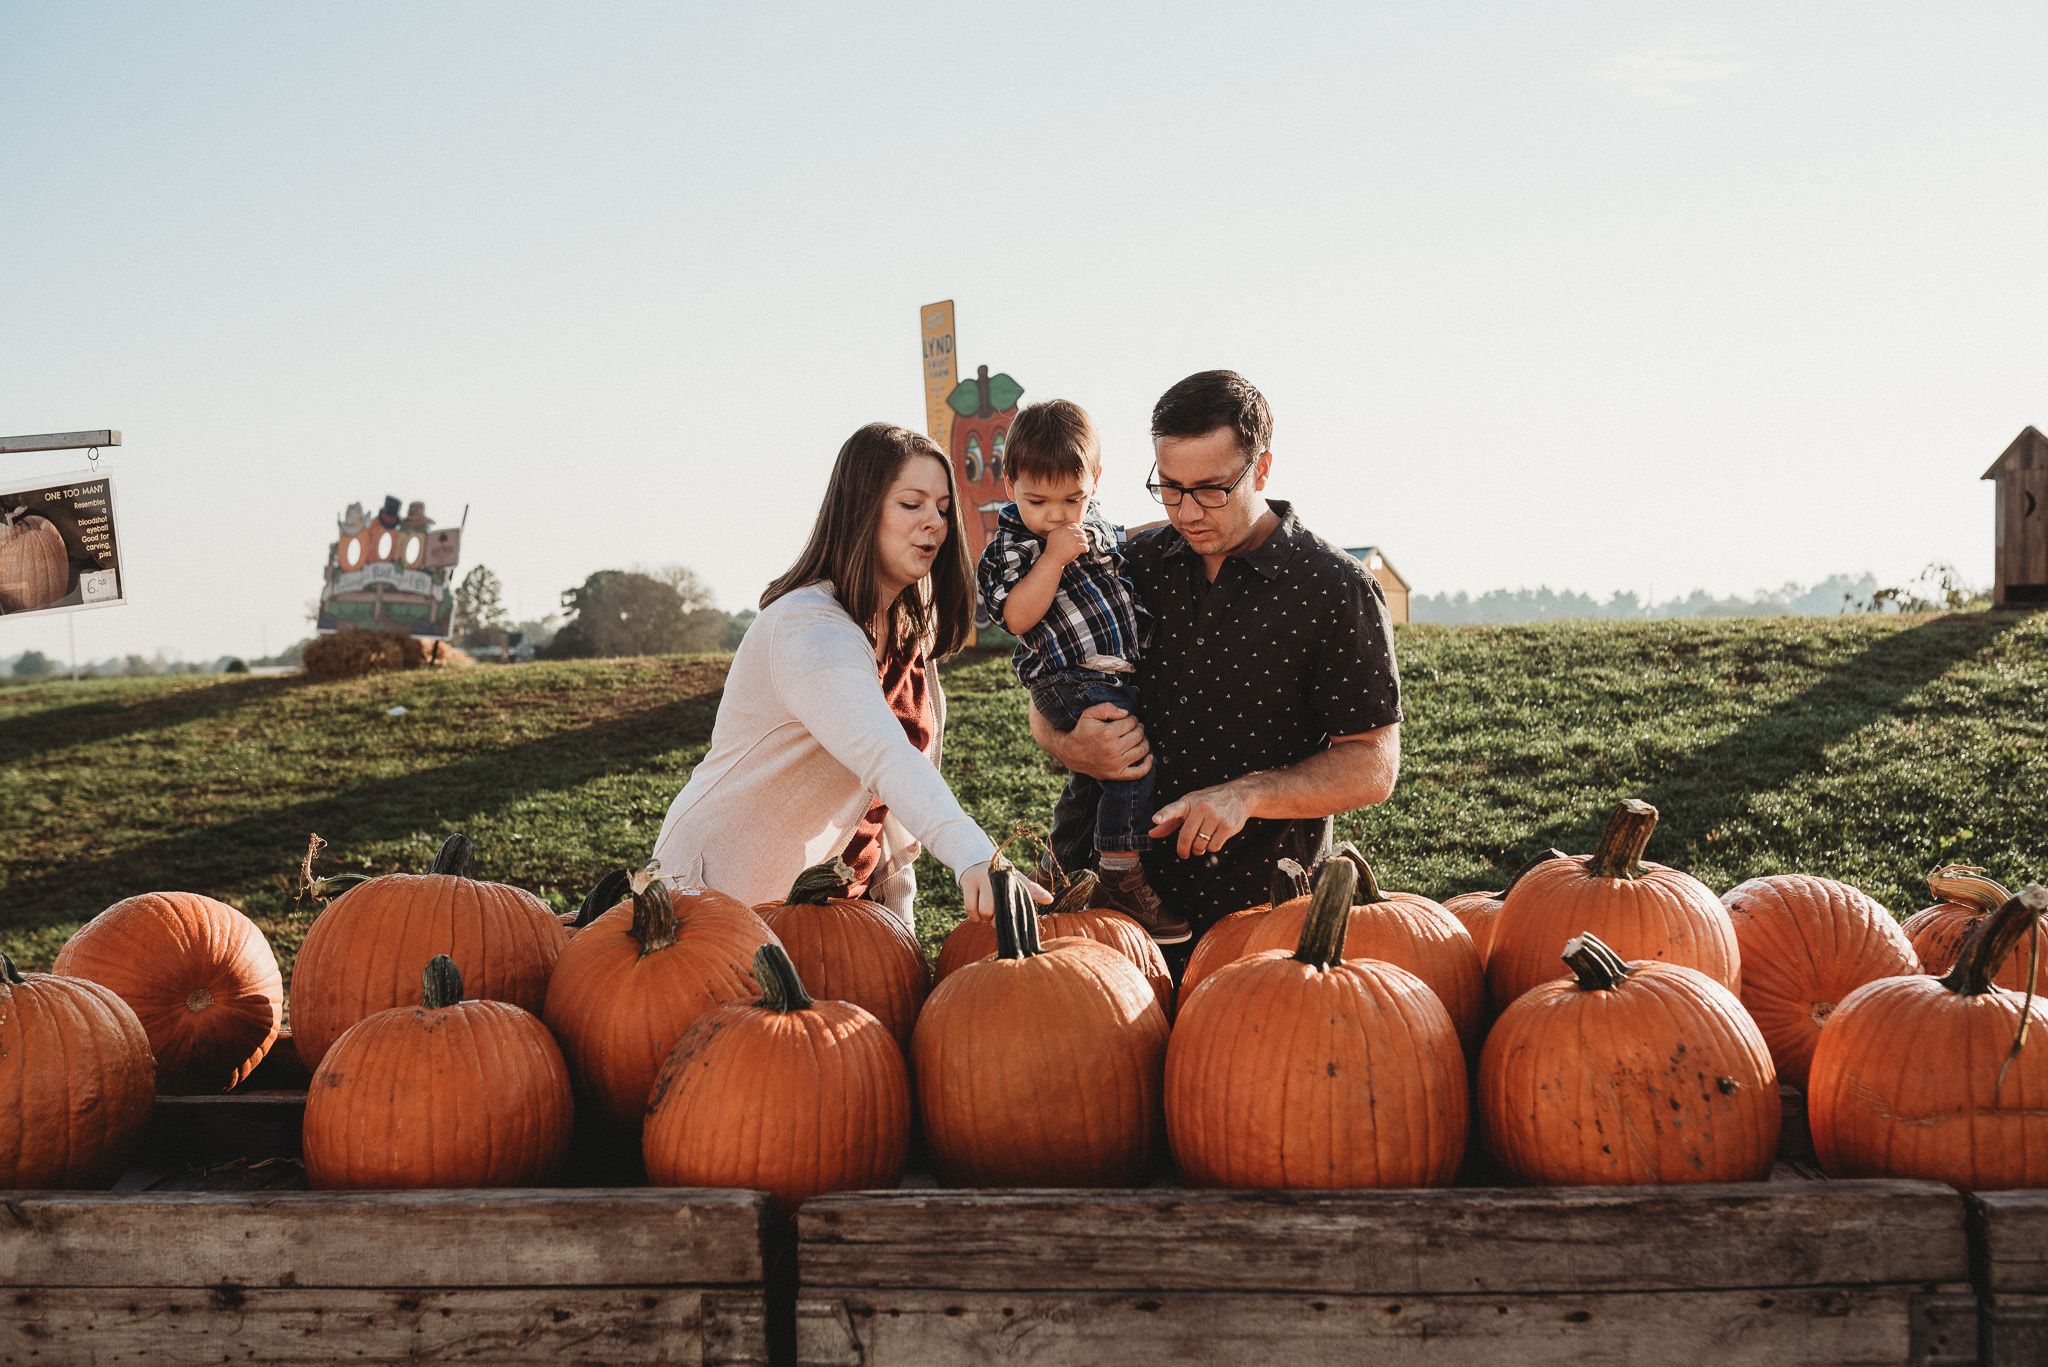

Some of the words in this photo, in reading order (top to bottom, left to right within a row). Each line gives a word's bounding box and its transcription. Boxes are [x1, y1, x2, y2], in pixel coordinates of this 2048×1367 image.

[923, 333, 953, 358] LYND
[44, 491, 62, 501] ONE
[63, 488, 80, 498] TOO
[82, 484, 104, 495] MANY
[74, 499, 106, 509] Resembles
[77, 516, 108, 526] bloodshot
[86, 524, 109, 534] eyeball
[81, 534, 99, 543] Good
[100, 532, 110, 540] for
[99, 551, 112, 559] pies
